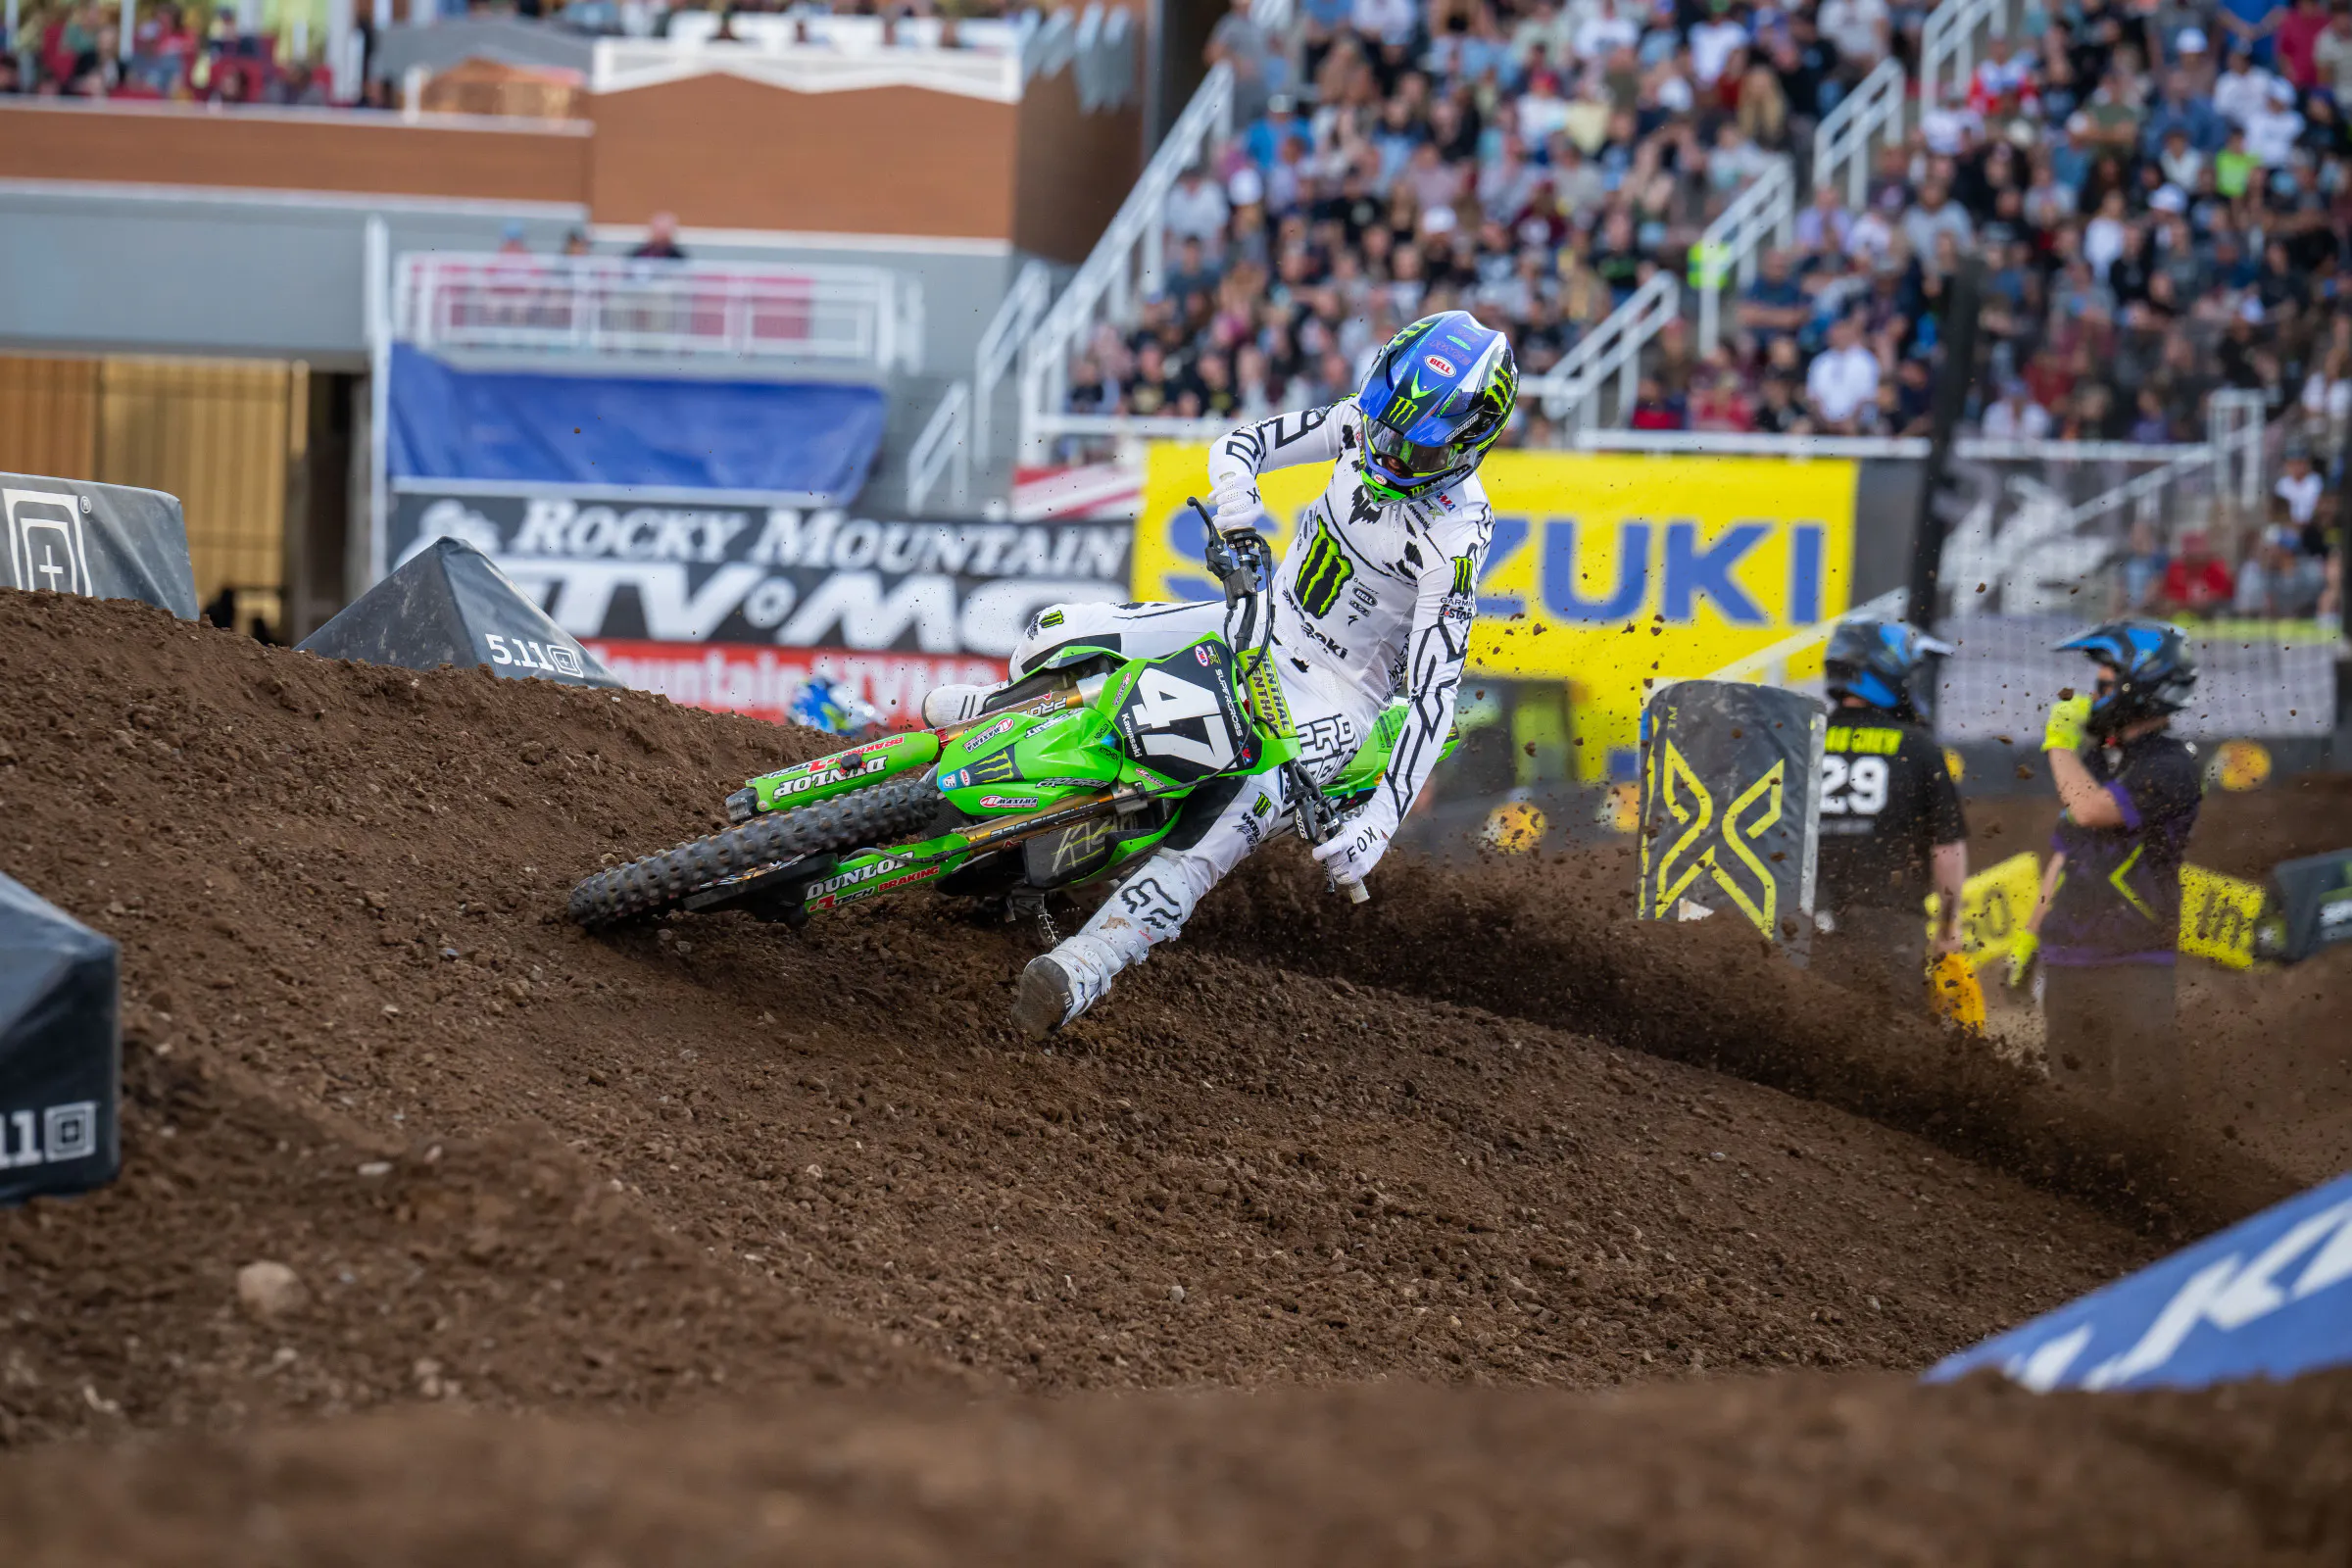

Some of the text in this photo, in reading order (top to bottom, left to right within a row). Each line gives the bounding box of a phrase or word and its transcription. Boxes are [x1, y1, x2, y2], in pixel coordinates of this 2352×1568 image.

[1429, 357, 1450, 374] BELL
[512, 499, 1132, 577] ROCKY MOUNTAIN
[1355, 590, 1374, 606] BELL
[485, 633, 555, 671] 5.11
[1131, 666, 1238, 771] 47
[1214, 668, 1244, 738] SUPERCROSS
[1121, 711, 1143, 759] Kawasaki
[1819, 754, 1890, 815] 29
[1346, 826, 1378, 862] FOX
[877, 865, 941, 893] BRAKING
